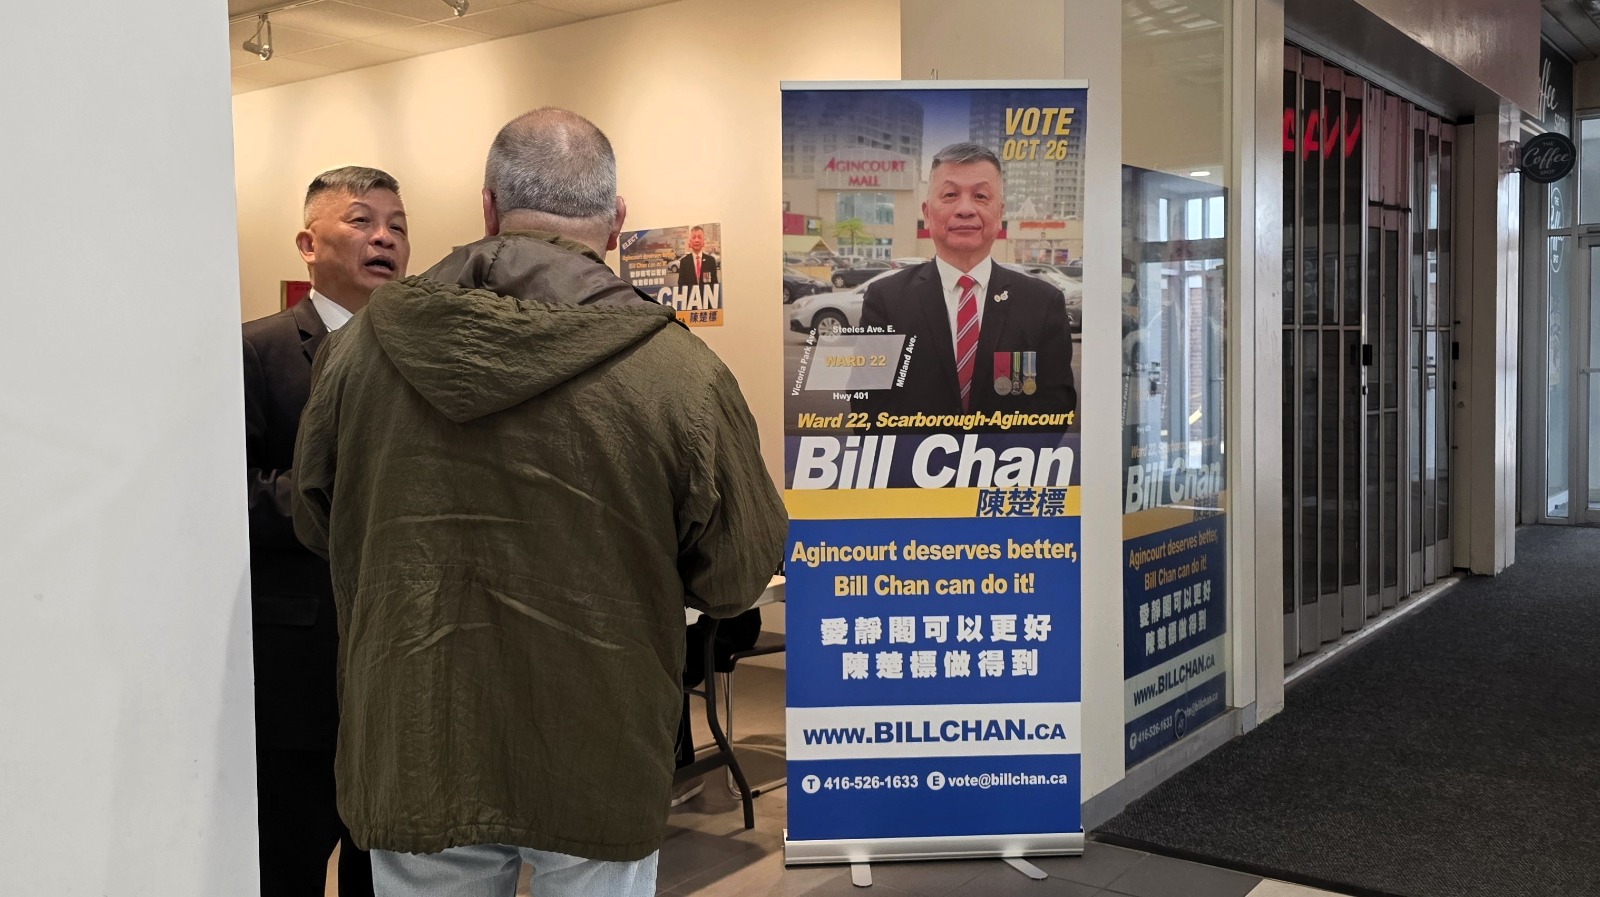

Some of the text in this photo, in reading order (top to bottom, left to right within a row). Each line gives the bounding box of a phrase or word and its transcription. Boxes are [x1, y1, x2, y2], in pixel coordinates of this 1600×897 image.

[1539, 57, 1558, 123] ffee
[1004, 107, 1075, 136] VOTE
[1002, 139, 1067, 161] OCT 26
[1522, 147, 1569, 169] Coffee
[823, 157, 906, 173] AGINCOURT
[848, 175, 880, 187] MALL
[621, 232, 639, 250] ELECT
[657, 283, 720, 311] CHAN
[832, 325, 896, 333] Steeles Ave. E.
[791, 327, 817, 396] Victoria Park Ave.
[825, 355, 888, 368] WARD 22
[896, 335, 917, 388] Midland Ave.
[833, 391, 869, 402] Hwy 401
[797, 410, 1075, 431] Ward 22, Scarborough-Agincourt
[792, 433, 1075, 490] Bill Chan
[1125, 459, 1166, 515] Bill
[1169, 457, 1221, 504] Chan
[976, 487, 1068, 517] 陳楚標
[790, 538, 1077, 568] Agincourt deserves better,
[1128, 541, 1166, 571] Agincourt
[1167, 533, 1198, 555] deserves
[834, 572, 1036, 597] Bill Chan can do it!
[1144, 571, 1157, 591] Bill
[1158, 567, 1177, 586] Chan
[1177, 563, 1190, 579] can
[1191, 557, 1200, 574] do
[820, 613, 1052, 646] 愛靜閣可以更好
[842, 648, 1039, 680] 陳楚標做得到
[823, 775, 919, 790] 416-526-1633
[948, 773, 1068, 790] vote@billchan.ca
